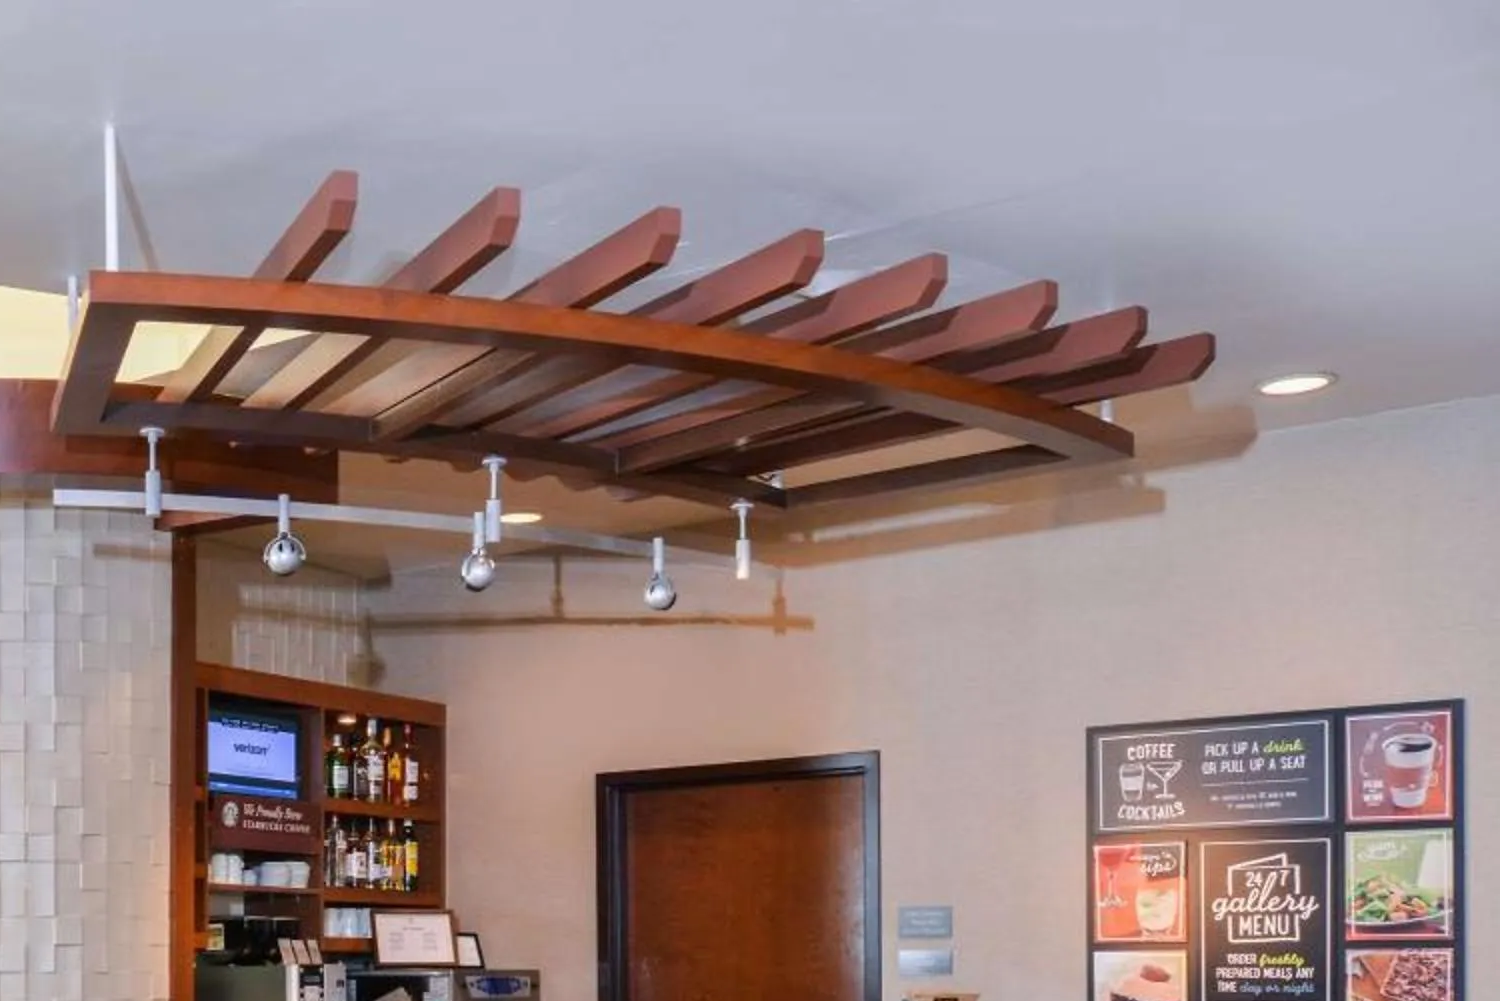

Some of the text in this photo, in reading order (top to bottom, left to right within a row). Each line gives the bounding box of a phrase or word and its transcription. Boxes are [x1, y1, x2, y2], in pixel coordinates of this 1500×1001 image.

[233, 743, 267, 756] verizon
[1127, 743, 1176, 760] COFFEE
[1204, 738, 1304, 757] PICK UP A drink
[1201, 755, 1306, 775] OR PULL UP A SEAT
[1117, 801, 1186, 821] COCKTAILS
[1211, 871, 1320, 921] gallery
[1238, 914, 1290, 937] MENU
[1227, 953, 1305, 969] ORDER freshly
[1215, 967, 1314, 980] PREPARED MEALS ANY
[1217, 981, 1315, 996] TIME day or night
